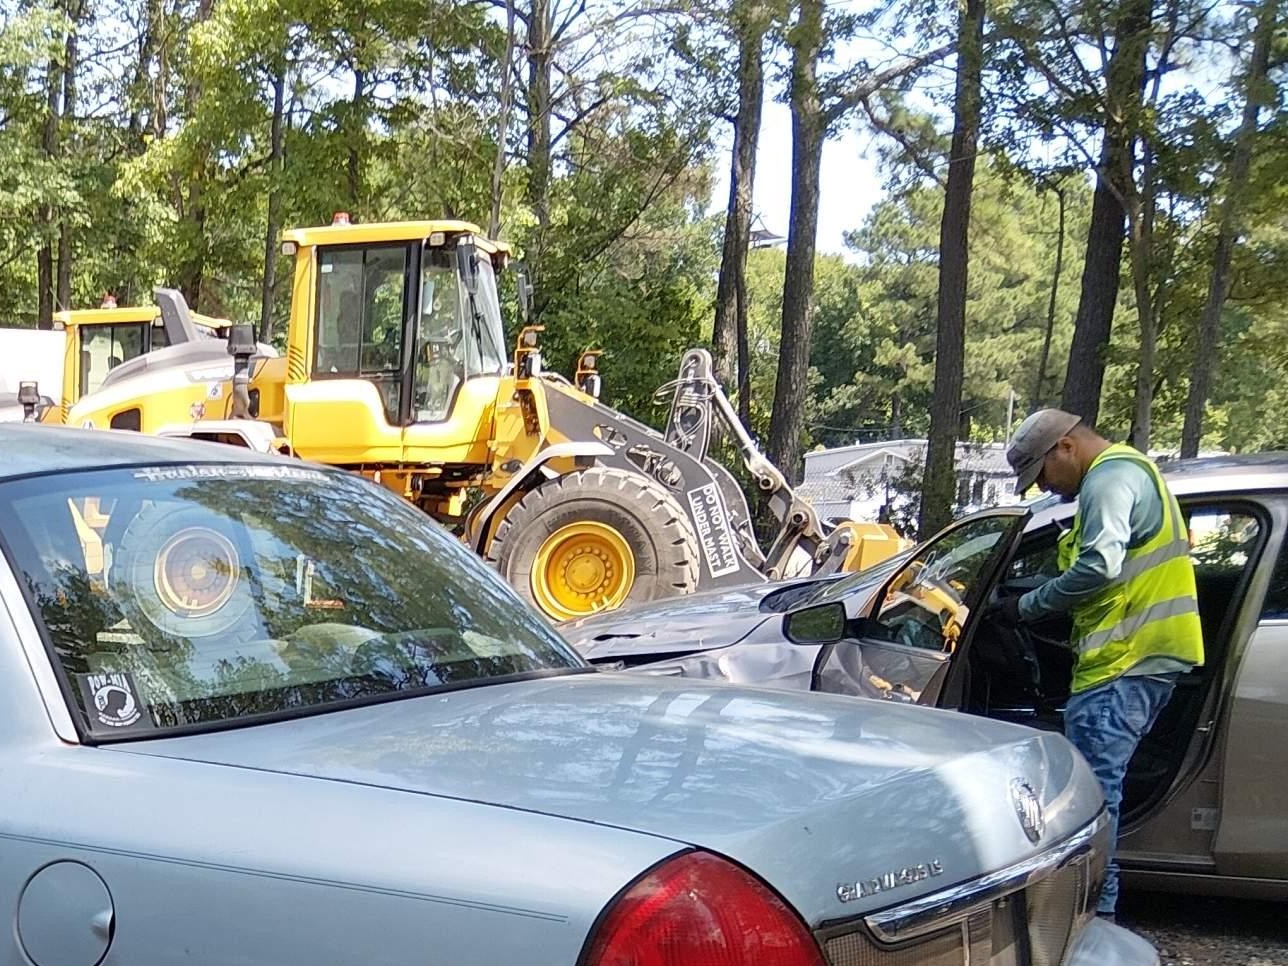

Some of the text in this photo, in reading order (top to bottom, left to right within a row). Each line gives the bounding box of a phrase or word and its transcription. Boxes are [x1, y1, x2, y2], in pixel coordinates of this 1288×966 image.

[693, 496, 722, 567] UNDER MAST
[703, 487, 736, 567] DO NOT WALK
